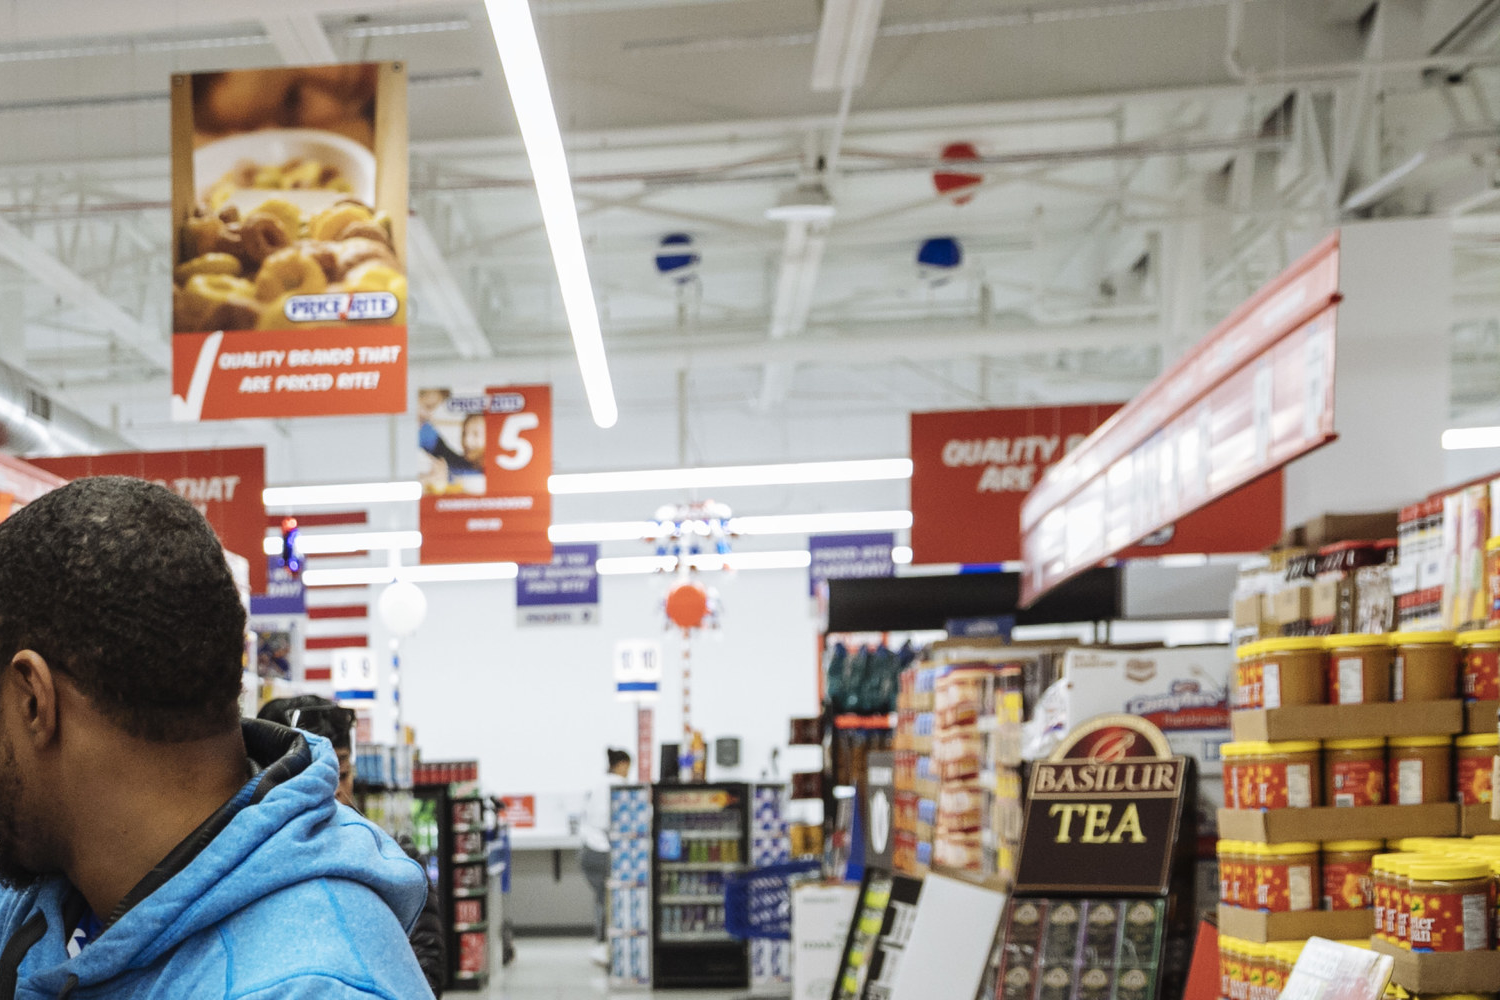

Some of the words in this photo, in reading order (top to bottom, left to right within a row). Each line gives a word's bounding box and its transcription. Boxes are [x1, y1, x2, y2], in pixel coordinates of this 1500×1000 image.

[218, 351, 286, 370] QUALITY
[287, 348, 354, 367] BRANDS
[357, 345, 402, 364] THAT
[238, 376, 272, 394] ARE
[274, 373, 333, 392] PRICED
[336, 371, 380, 390] RITE!
[495, 412, 539, 470] 5
[942, 436, 1059, 467] QUALITY
[176, 476, 240, 503] THAT
[977, 468, 1036, 492] ARE
[1035, 764, 1176, 793] BASILUR
[1048, 802, 1147, 844] TEA
